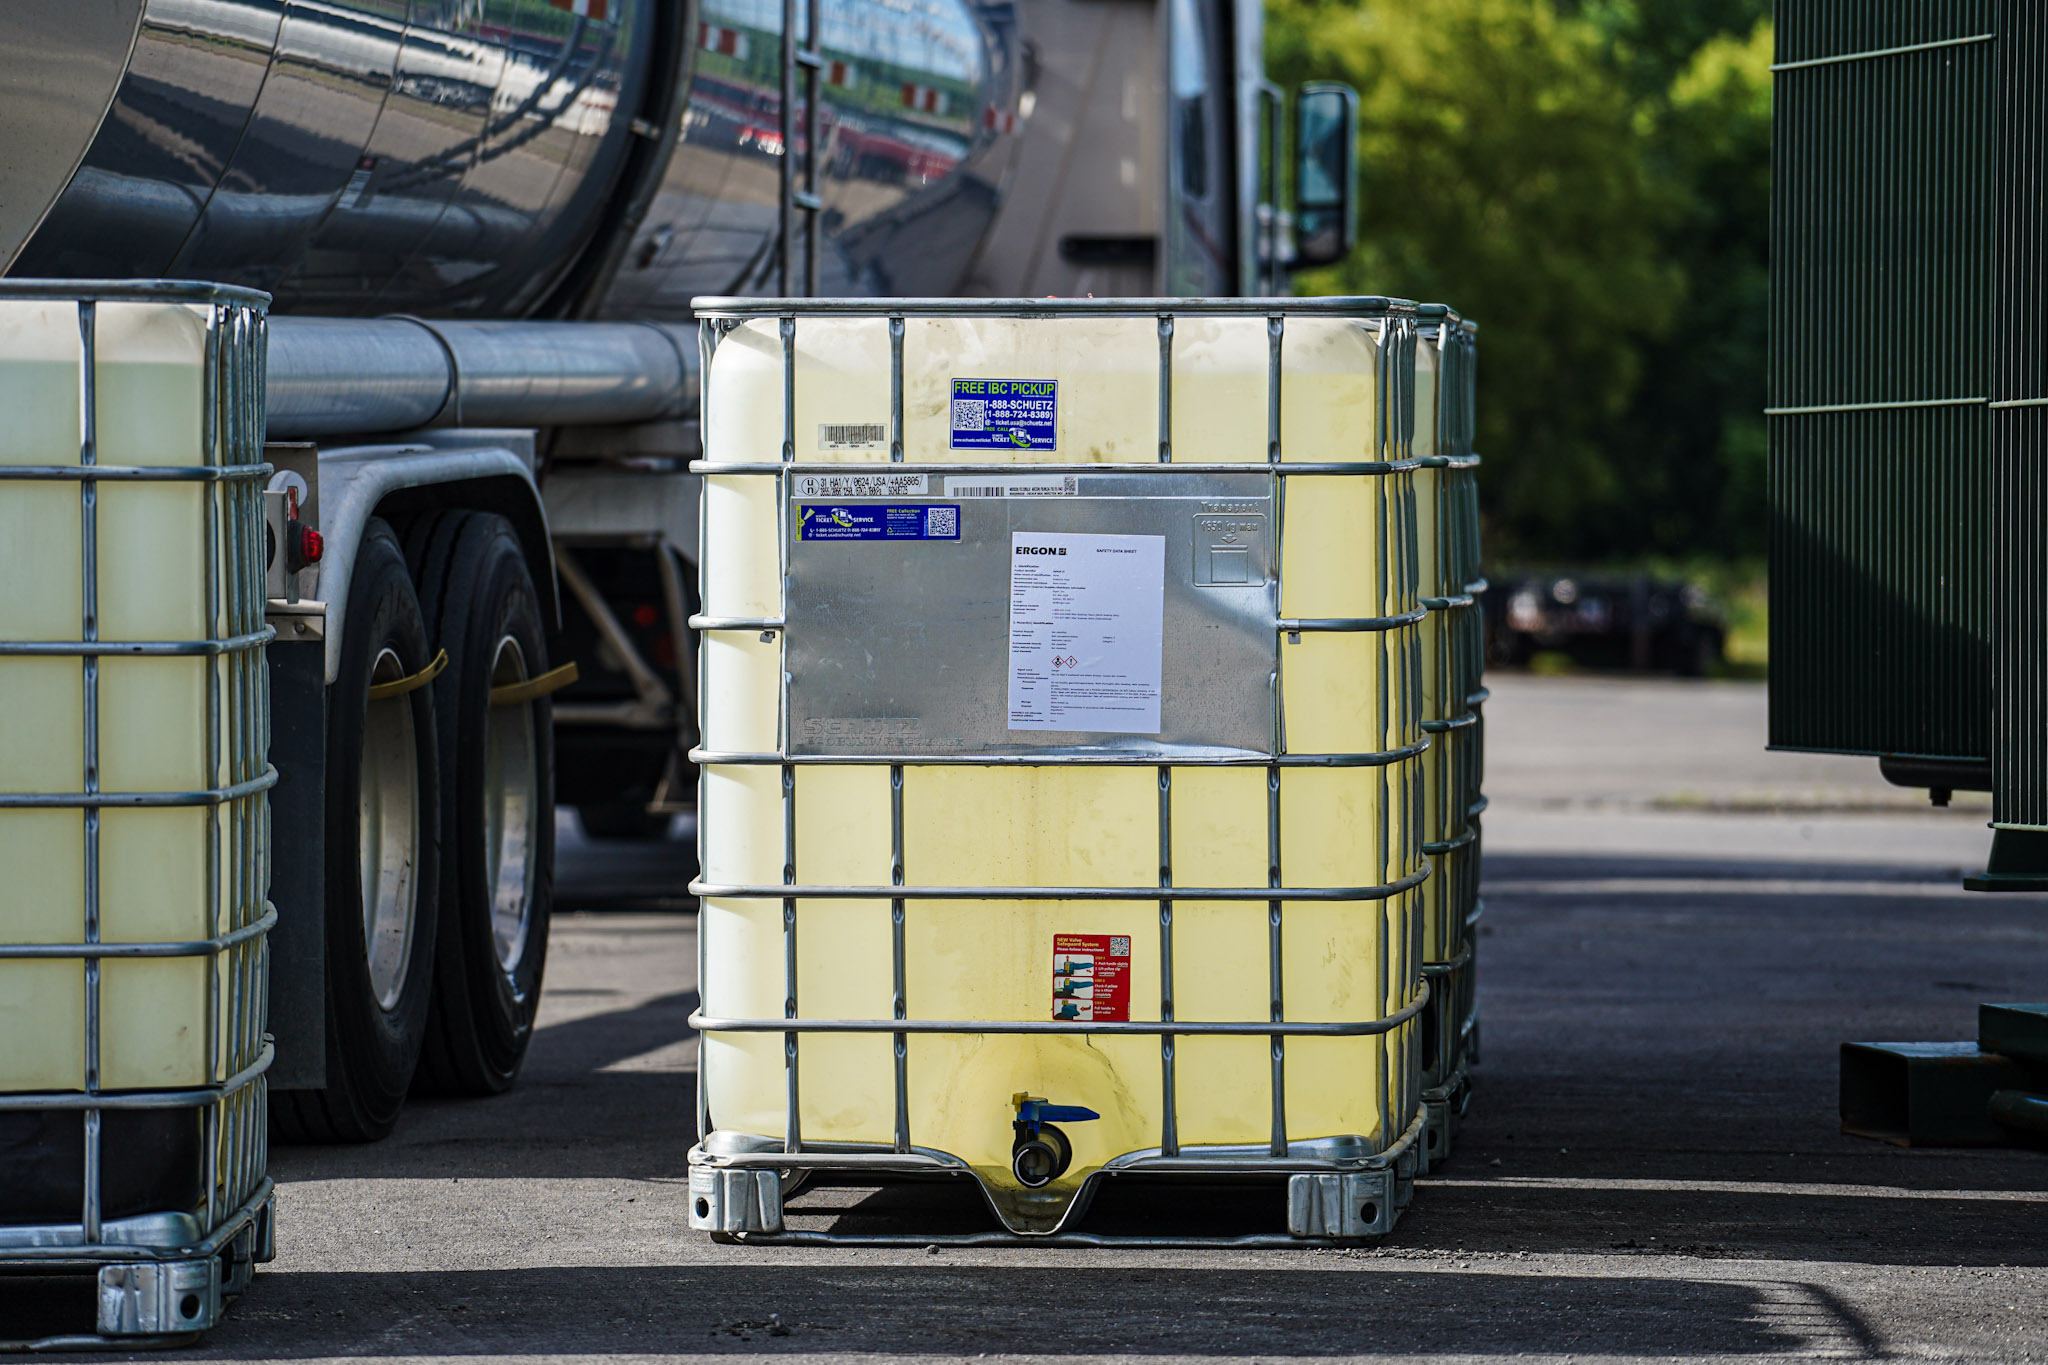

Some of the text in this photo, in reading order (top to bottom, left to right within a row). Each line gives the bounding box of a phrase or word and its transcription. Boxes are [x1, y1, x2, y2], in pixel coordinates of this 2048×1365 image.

[954, 381, 1055, 395] FREE IBC PICKUP
[984, 400, 1053, 410] 1-888-SCHUETZ
[984, 410, 1054, 420] (1-888-724-8389)
[1200, 501, 1259, 513] Transport
[1226, 520, 1237, 533] kg
[1240, 522, 1258, 532] max
[1015, 546, 1057, 556] ERGON
